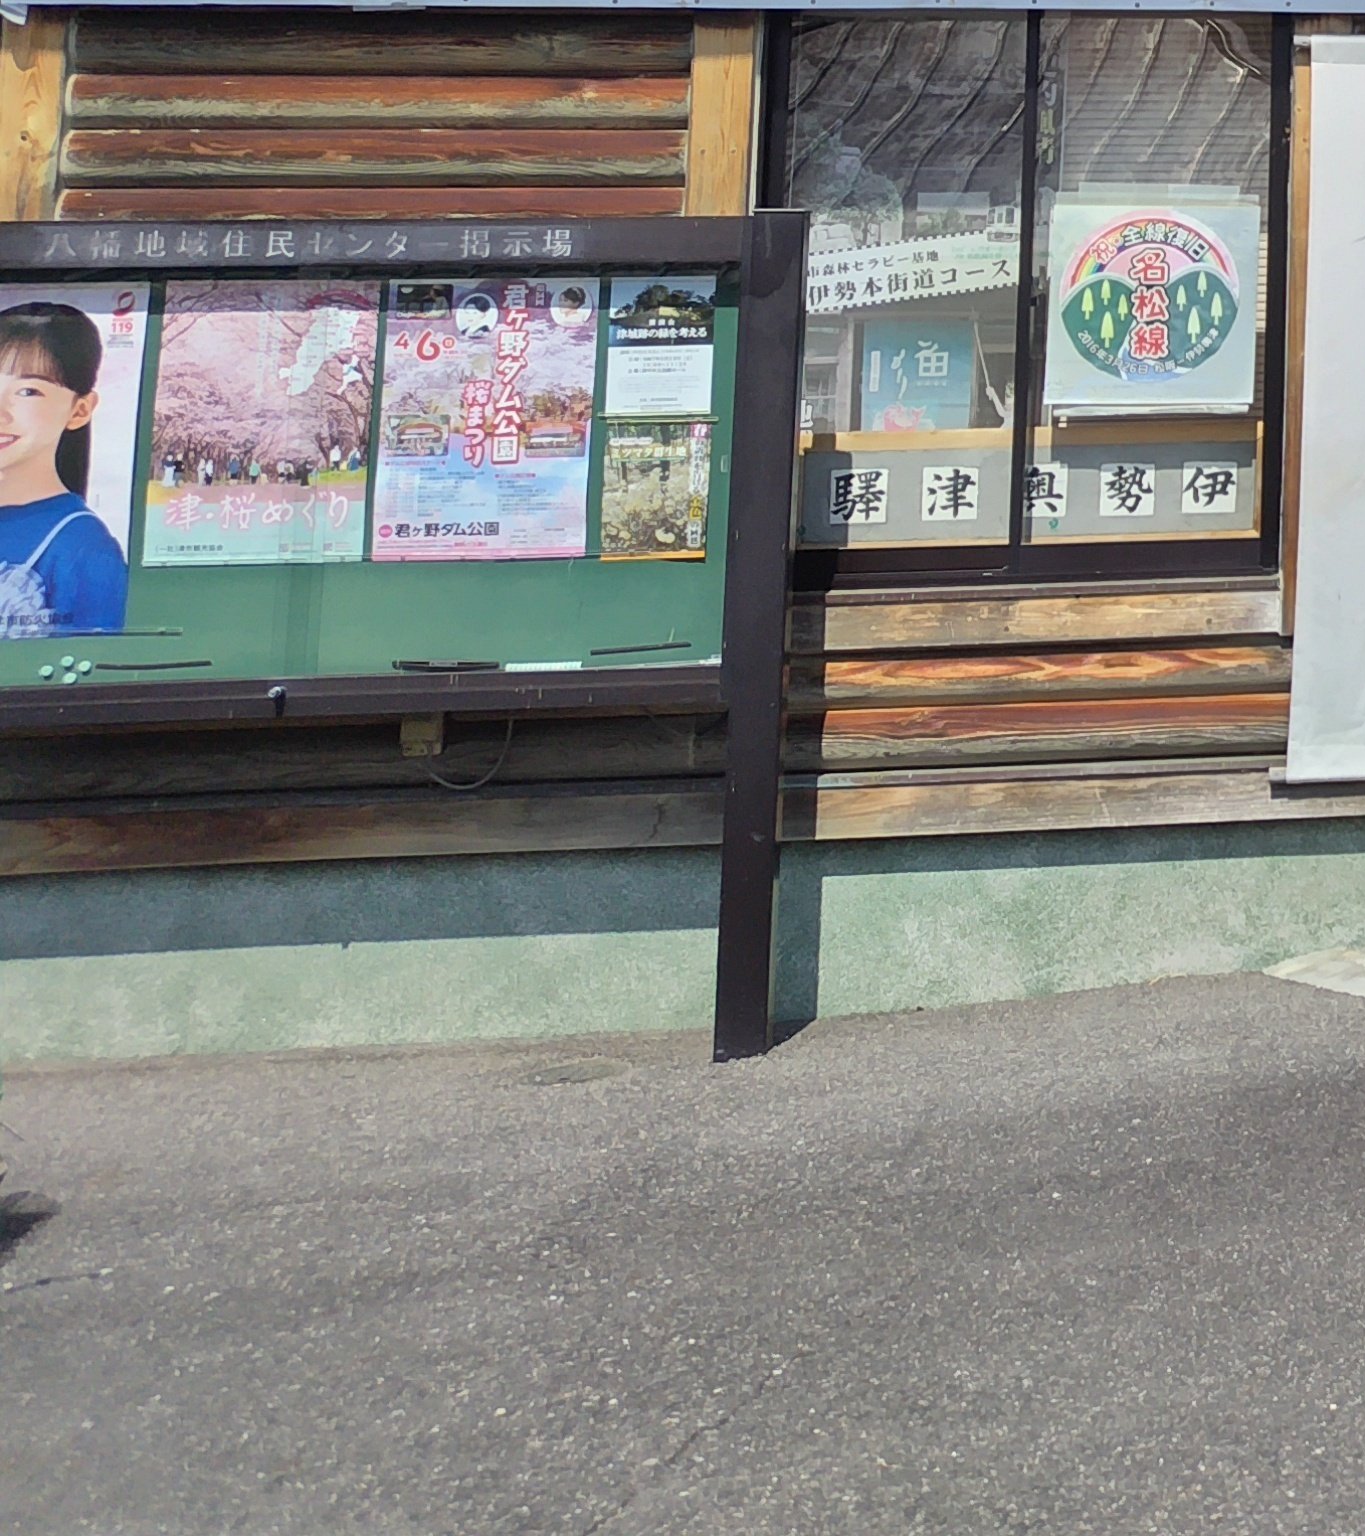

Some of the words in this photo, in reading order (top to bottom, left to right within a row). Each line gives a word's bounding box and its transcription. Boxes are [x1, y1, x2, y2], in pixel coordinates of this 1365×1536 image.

[808, 259, 1011, 306] 伊勢本街道コース
[1128, 247, 1170, 360] 名松線
[111, 322, 134, 334] 119
[464, 381, 492, 467] 桜まつり
